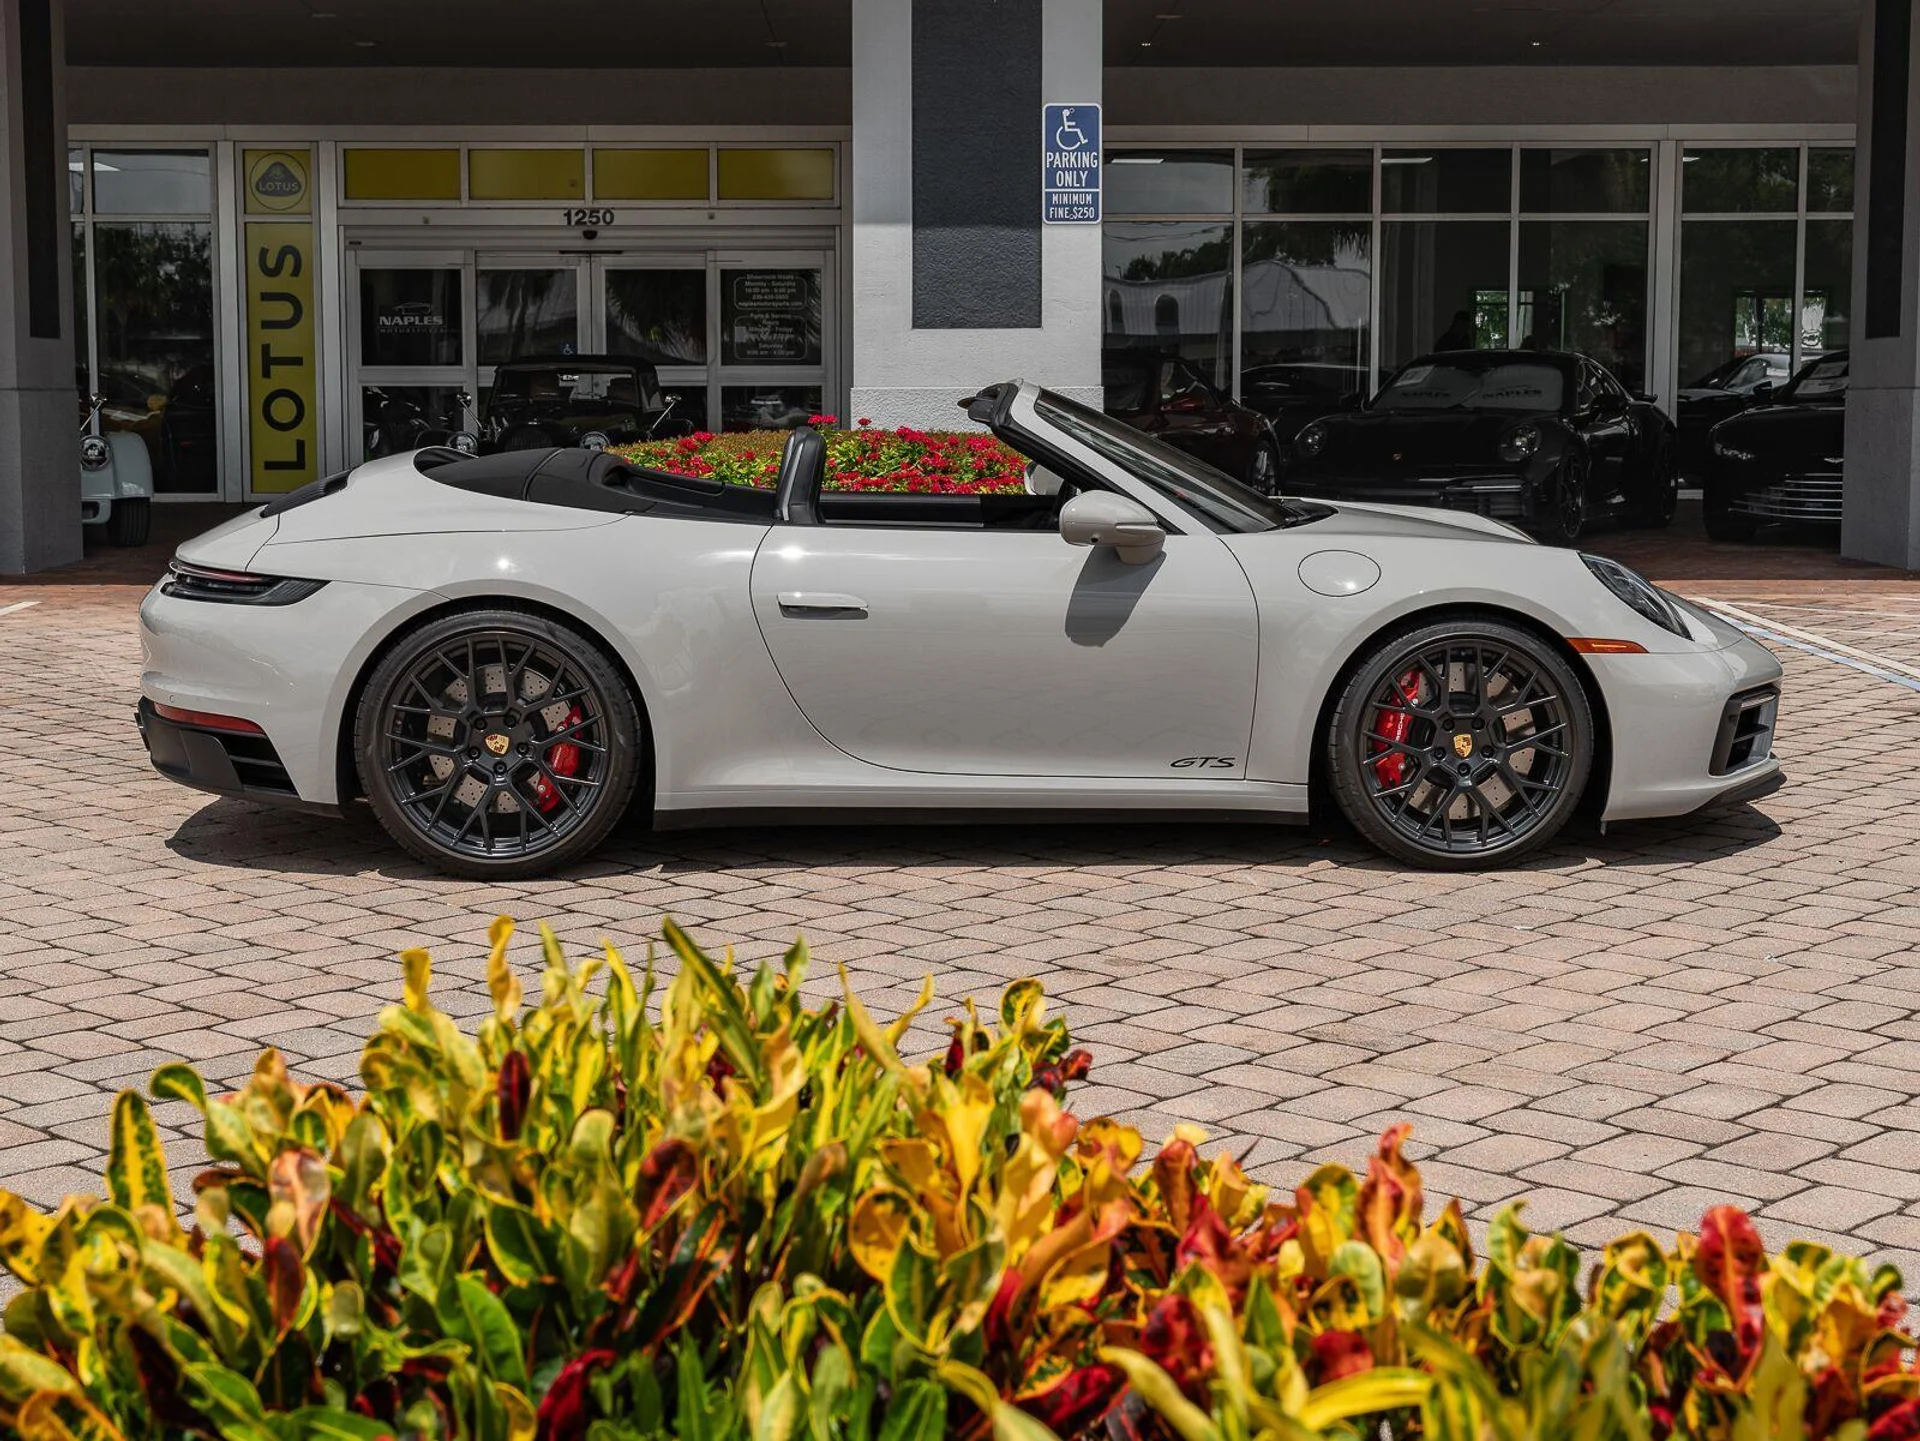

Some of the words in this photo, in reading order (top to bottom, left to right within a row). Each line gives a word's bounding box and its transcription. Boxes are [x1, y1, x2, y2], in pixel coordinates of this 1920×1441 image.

[1046, 152, 1098, 168] PARKING
[1056, 170, 1088, 187] ONLY
[259, 182, 299, 191] LOTUS
[1052, 193, 1092, 205] MINIMUM
[563, 209, 615, 226] 1250
[1049, 207, 1069, 219] FINE
[1072, 206, 1095, 220] $250
[380, 315, 443, 326] NAPLES
[258, 244, 306, 471] LOTUS
[1170, 757, 1236, 768] GTS
